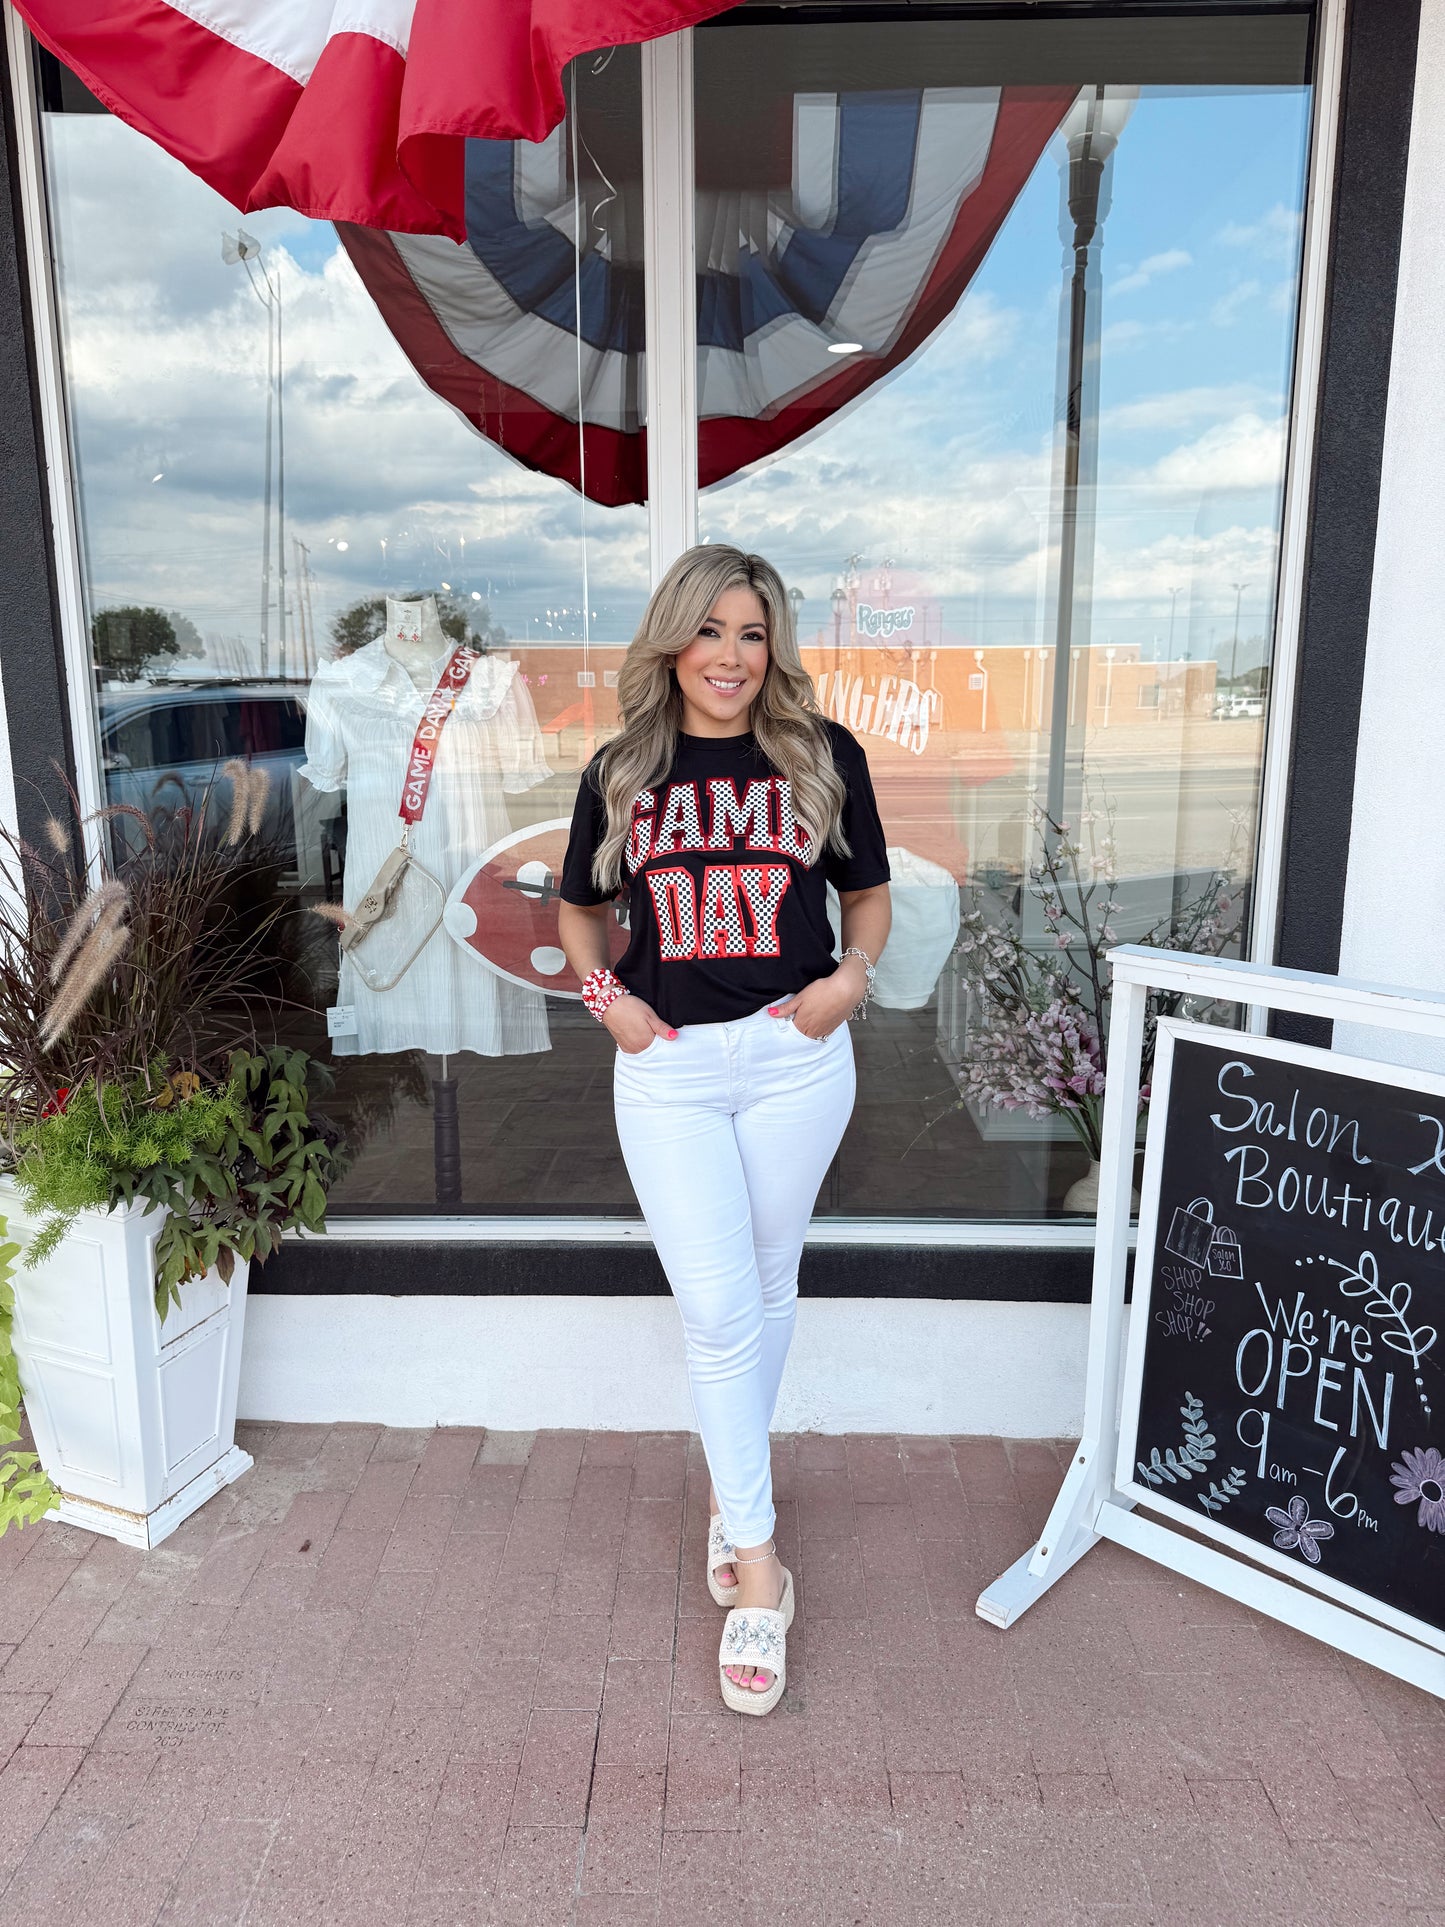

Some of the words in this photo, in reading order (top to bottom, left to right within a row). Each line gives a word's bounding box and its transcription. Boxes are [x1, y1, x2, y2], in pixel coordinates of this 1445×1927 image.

[857, 603, 915, 638] Rangers
[405, 747, 432, 811] GAME
[420, 696, 453, 740] DAY
[449, 646, 480, 679] GAM
[815, 669, 938, 756] ANGERS
[645, 864, 791, 962] DAY
[1210, 1061, 1373, 1165] Salon
[1161, 1266, 1202, 1290] SHOP
[1211, 1249, 1236, 1262] Salon
[1173, 1291, 1216, 1320] SHOP
[1255, 1282, 1373, 1363] We're
[1236, 1328, 1394, 1450] OPEN
